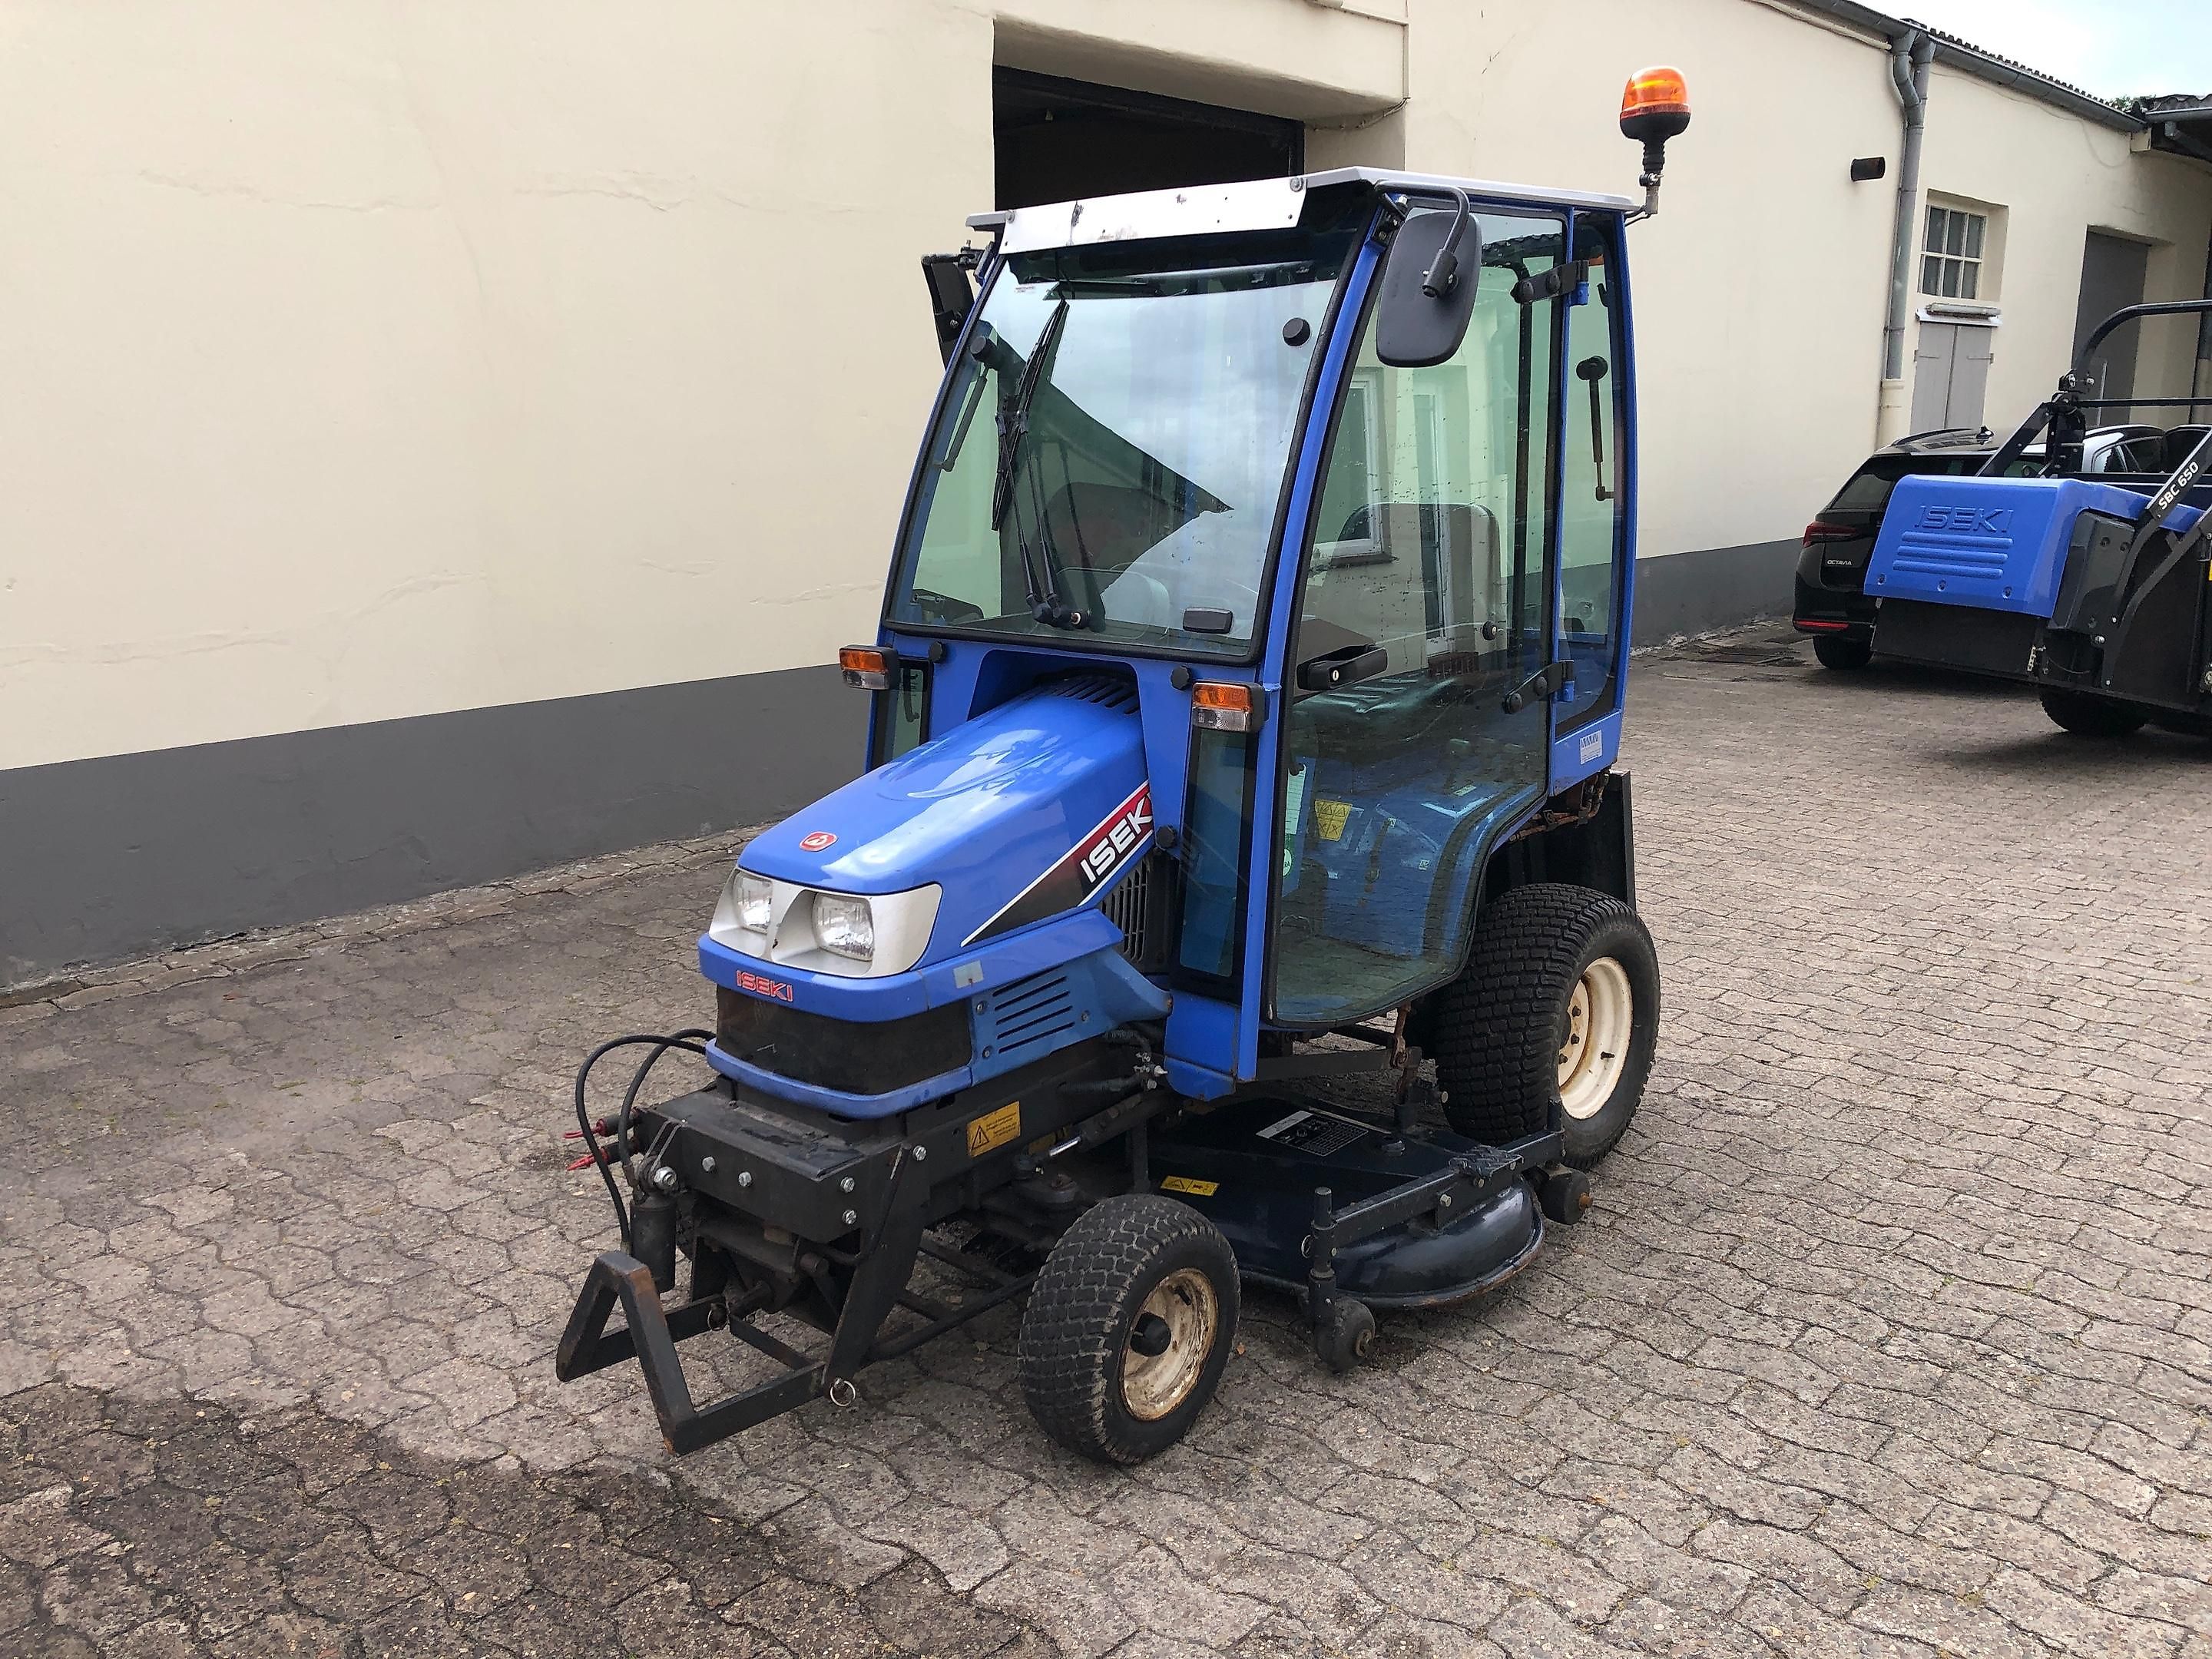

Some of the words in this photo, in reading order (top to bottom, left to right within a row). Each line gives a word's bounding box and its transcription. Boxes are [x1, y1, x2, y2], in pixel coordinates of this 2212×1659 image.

[2158, 484, 2180, 510] SBC
[2177, 461, 2199, 487] 650
[1914, 505, 2014, 532] ISEKI
[1080, 793, 1153, 883] ISEK
[736, 969, 793, 1002] ISEKI
